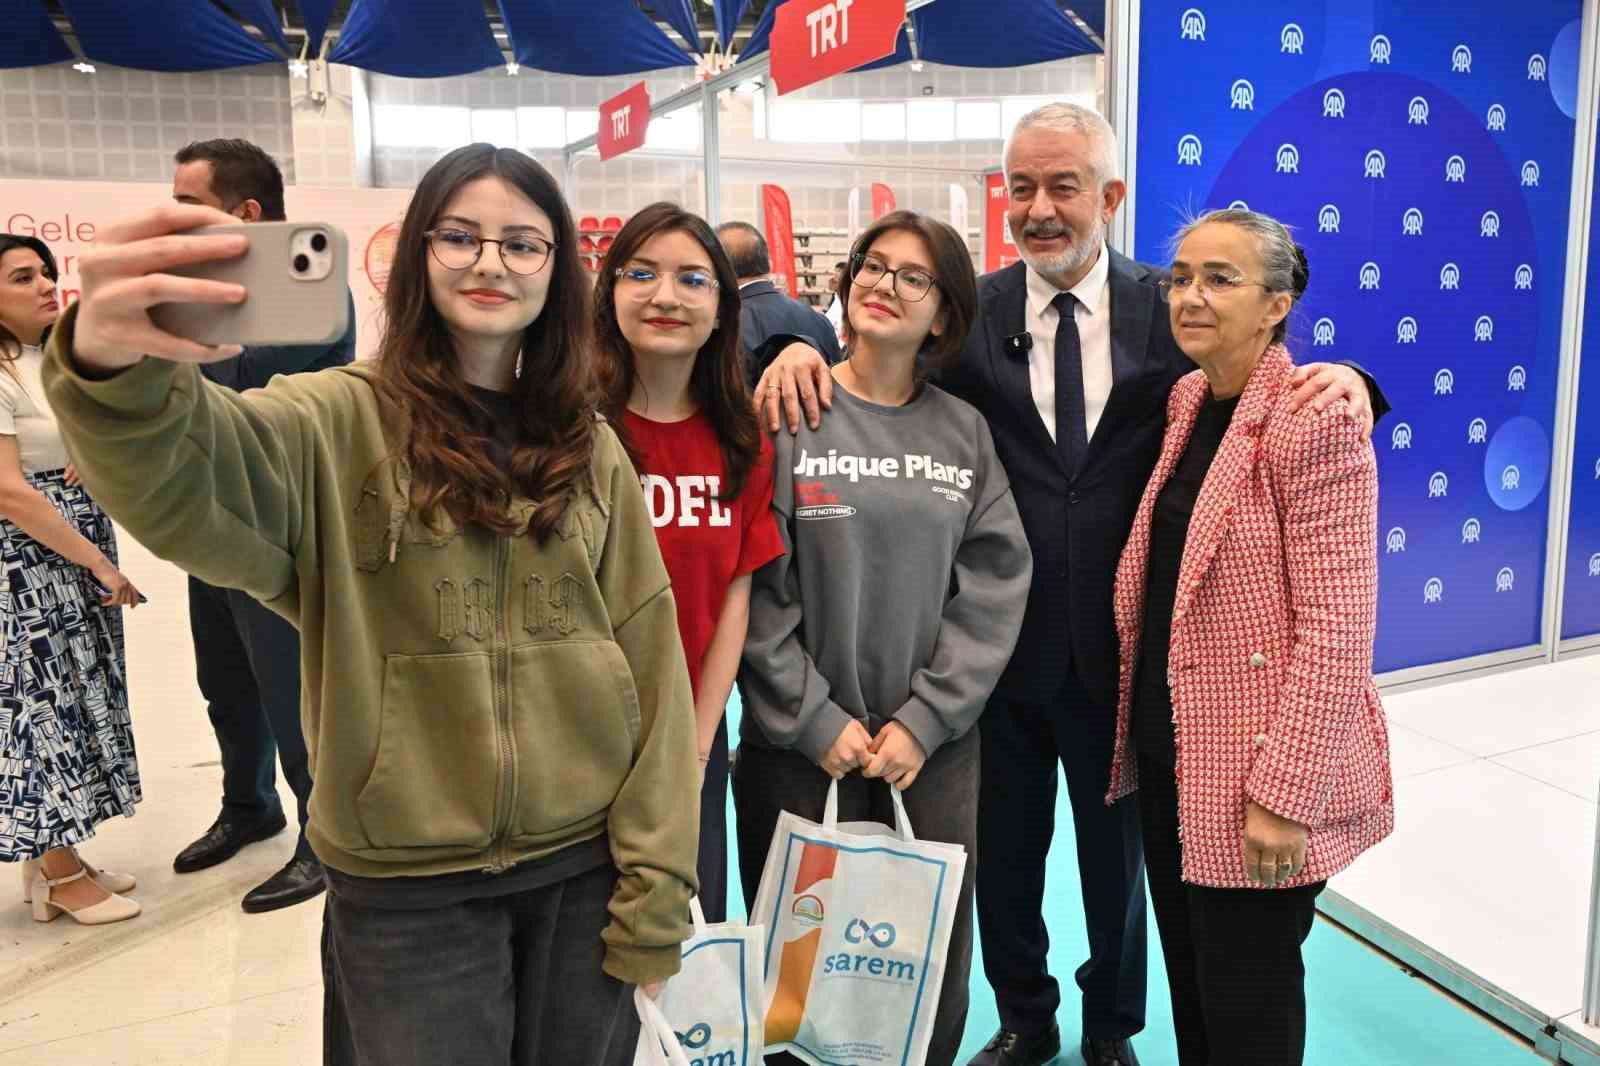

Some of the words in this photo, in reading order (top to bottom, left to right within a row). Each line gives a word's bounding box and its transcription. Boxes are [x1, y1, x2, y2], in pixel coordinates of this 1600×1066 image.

[806, 0, 854, 57] TRT
[1181, 16, 1206, 41] AA
[1281, 30, 1303, 54] AA
[1370, 42, 1391, 64] AA
[1452, 51, 1471, 72] AA
[1528, 60, 1545, 80] AA
[1231, 86, 1254, 110] AA
[1323, 95, 1345, 118] AA
[611, 106, 631, 141] TRT
[1408, 103, 1429, 125] AA
[1487, 110, 1506, 131] AA
[1178, 141, 1202, 165] AA
[1276, 151, 1299, 173] AA
[1364, 156, 1385, 178] AA
[1446, 161, 1465, 182] AA
[1521, 166, 1539, 186] AA
[1319, 210, 1340, 232] AA
[1403, 214, 1423, 235] AA
[1481, 216, 1499, 237] AA
[1360, 268, 1380, 289] AA
[1440, 269, 1459, 289] AA
[1515, 270, 1532, 289] AA
[1314, 323, 1335, 345] AA
[1397, 322, 1417, 343] AA
[1474, 321, 1493, 341] AA
[1434, 374, 1453, 394] AA
[1508, 371, 1526, 390] AA
[1392, 429, 1412, 449] AA
[1468, 424, 1487, 444] AA
[904, 454, 973, 490] Plans
[1502, 471, 1519, 489] AA
[1429, 478, 1448, 497] AA
[1387, 533, 1405, 552] AA
[1462, 524, 1480, 543] AA
[1496, 573, 1513, 592] AA
[1424, 584, 1442, 603] AA
[824, 952, 915, 980] sarem
